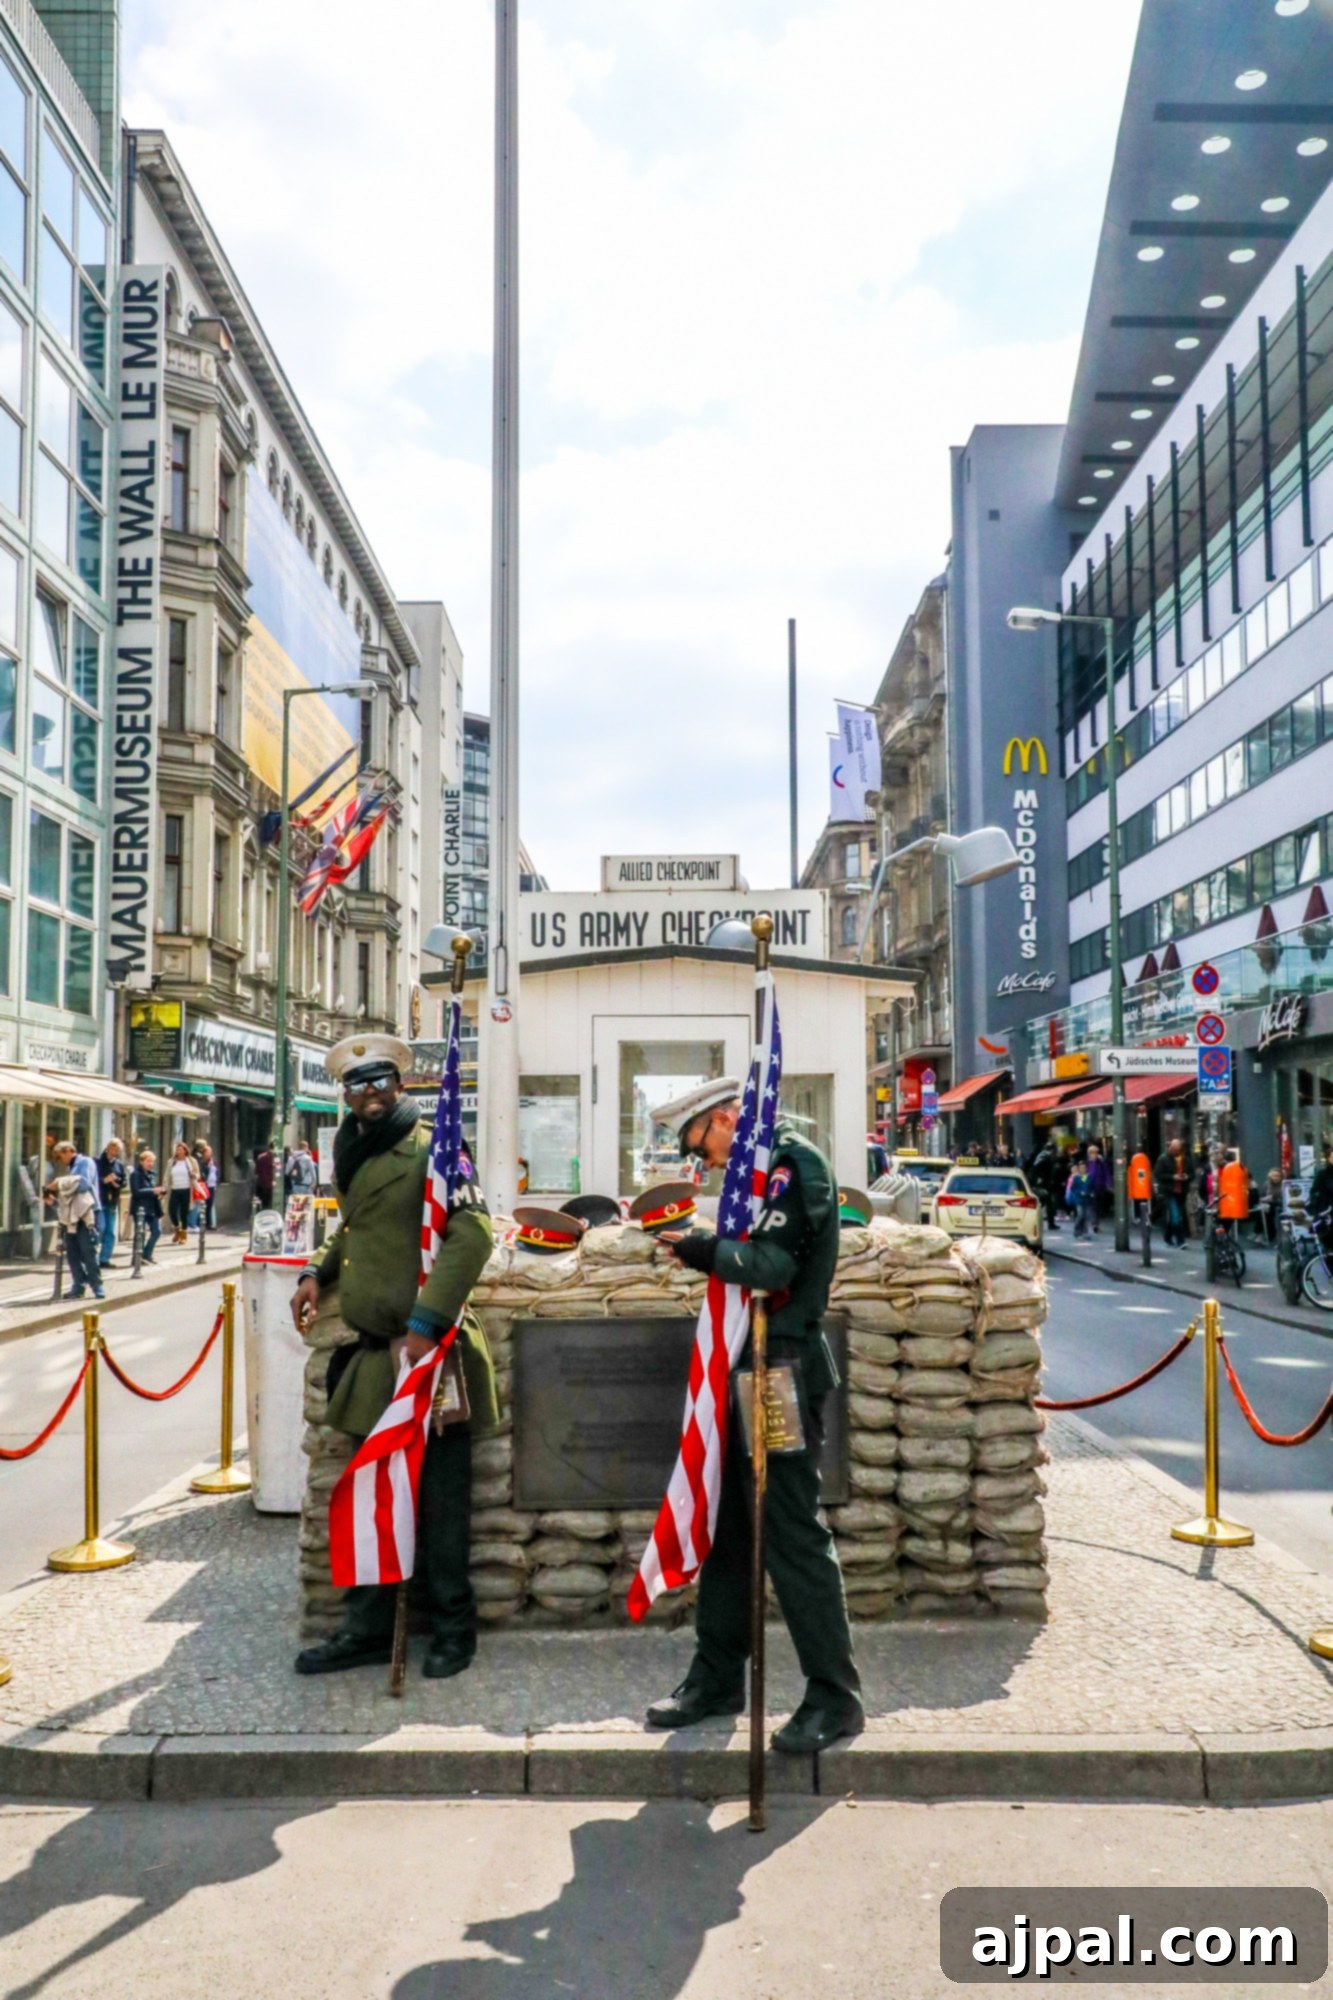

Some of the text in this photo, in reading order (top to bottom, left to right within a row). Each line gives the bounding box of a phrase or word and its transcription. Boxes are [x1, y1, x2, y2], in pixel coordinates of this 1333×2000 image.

[109, 279, 159, 973] MAUERMUSEUM THE WALL LE MUR
[444, 789, 460, 866] CHARLIE
[619, 860, 722, 882] ALLIED CHECKPOINT
[579, 911, 650, 947] ARMY
[661, 909, 811, 947] CHEINT
[188, 1033, 244, 1067] CHECKPOINT
[1125, 1056, 1197, 1066] Jüdisches Museum
[453, 1184, 484, 1207] MP
